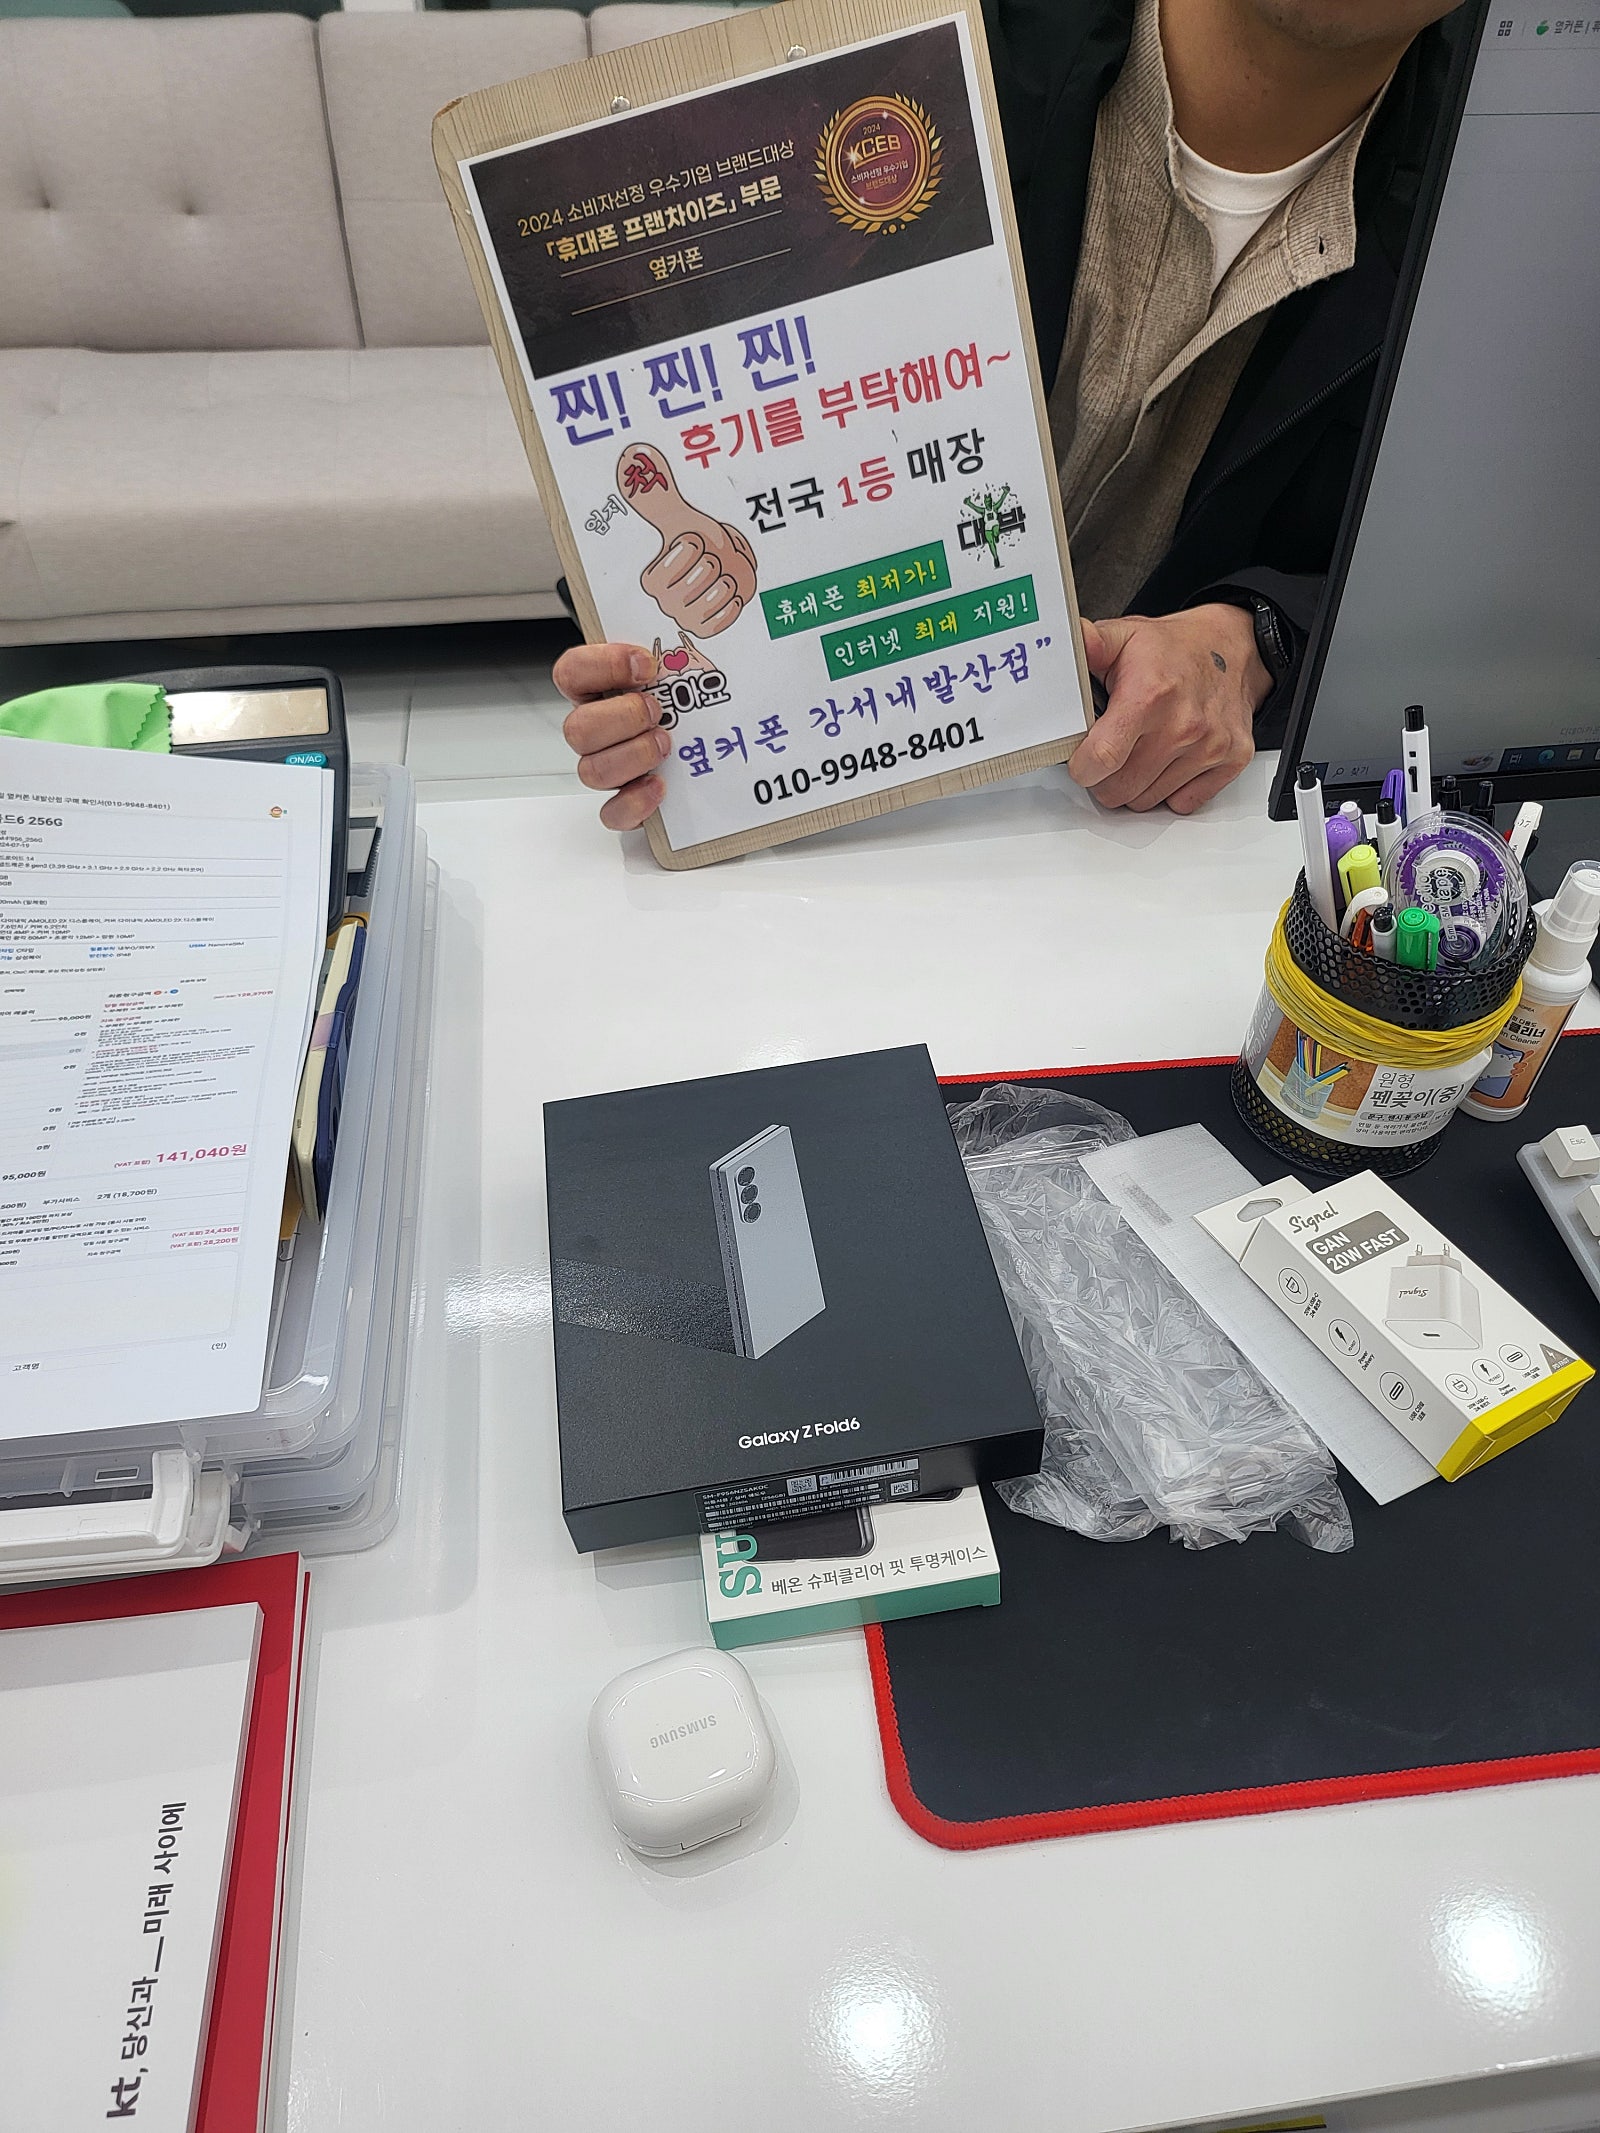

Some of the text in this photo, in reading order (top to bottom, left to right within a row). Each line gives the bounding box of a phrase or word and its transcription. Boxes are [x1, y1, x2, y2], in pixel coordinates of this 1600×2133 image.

[1554, 20, 1584, 33] 옆커폰
[863, 123, 880, 135] 2024
[850, 134, 901, 161] KCEB
[851, 160, 909, 184] 소비자선정 우수기업
[865, 175, 898, 190] 브랜드대상
[517, 138, 795, 238] 2024 소비자선정 우수기업 브랜드대상
[623, 195, 738, 244] 프랜차이즈」
[740, 175, 782, 207] 부문
[648, 246, 704, 282] 옆커폰
[550, 315, 817, 446] 찐! 찐! 찐!
[679, 342, 1014, 470] 후기를 부탁해여~
[745, 428, 988, 535] 전국 1등 매장
[584, 495, 629, 536] 엄지
[957, 505, 1026, 551] 대박
[774, 559, 938, 625] 휴대폰 최저가!
[834, 592, 1031, 666] 인터넷 최대 지원!
[289, 756, 322, 764] ON/AC
[677, 714, 790, 778] 옆커폰
[753, 717, 984, 805] 010-9948-8401
[0, 814, 63, 826] 드6 256G
[1504, 1020, 1546, 1038] 클리너
[1509, 1034, 1540, 1045] Cleaner
[1378, 1072, 1415, 1089] 원형
[1370, 1084, 1464, 1108] 펜꽂이(중)
[156, 1144, 247, 1163] 141,040원
[2, 1171, 46, 1180] 95,000원
[113, 1188, 157, 1199] (18,700원)
[204, 1226, 239, 1234] 24,430원
[1288, 1201, 1339, 1234] Signal
[203, 1237, 238, 1245] 28,200원
[1312, 1230, 1351, 1257] GAN
[1326, 1227, 1402, 1275] 20W FAST
[12, 1362, 40, 1371] 고객명
[738, 1416, 861, 1450] Galaxy Z Fold6
[771, 1545, 988, 1596] 베온 슈퍼클리어 핏 투명케이스
[649, 1714, 717, 1749] SAMSUNG
[153, 1802, 186, 1874] 사이에
